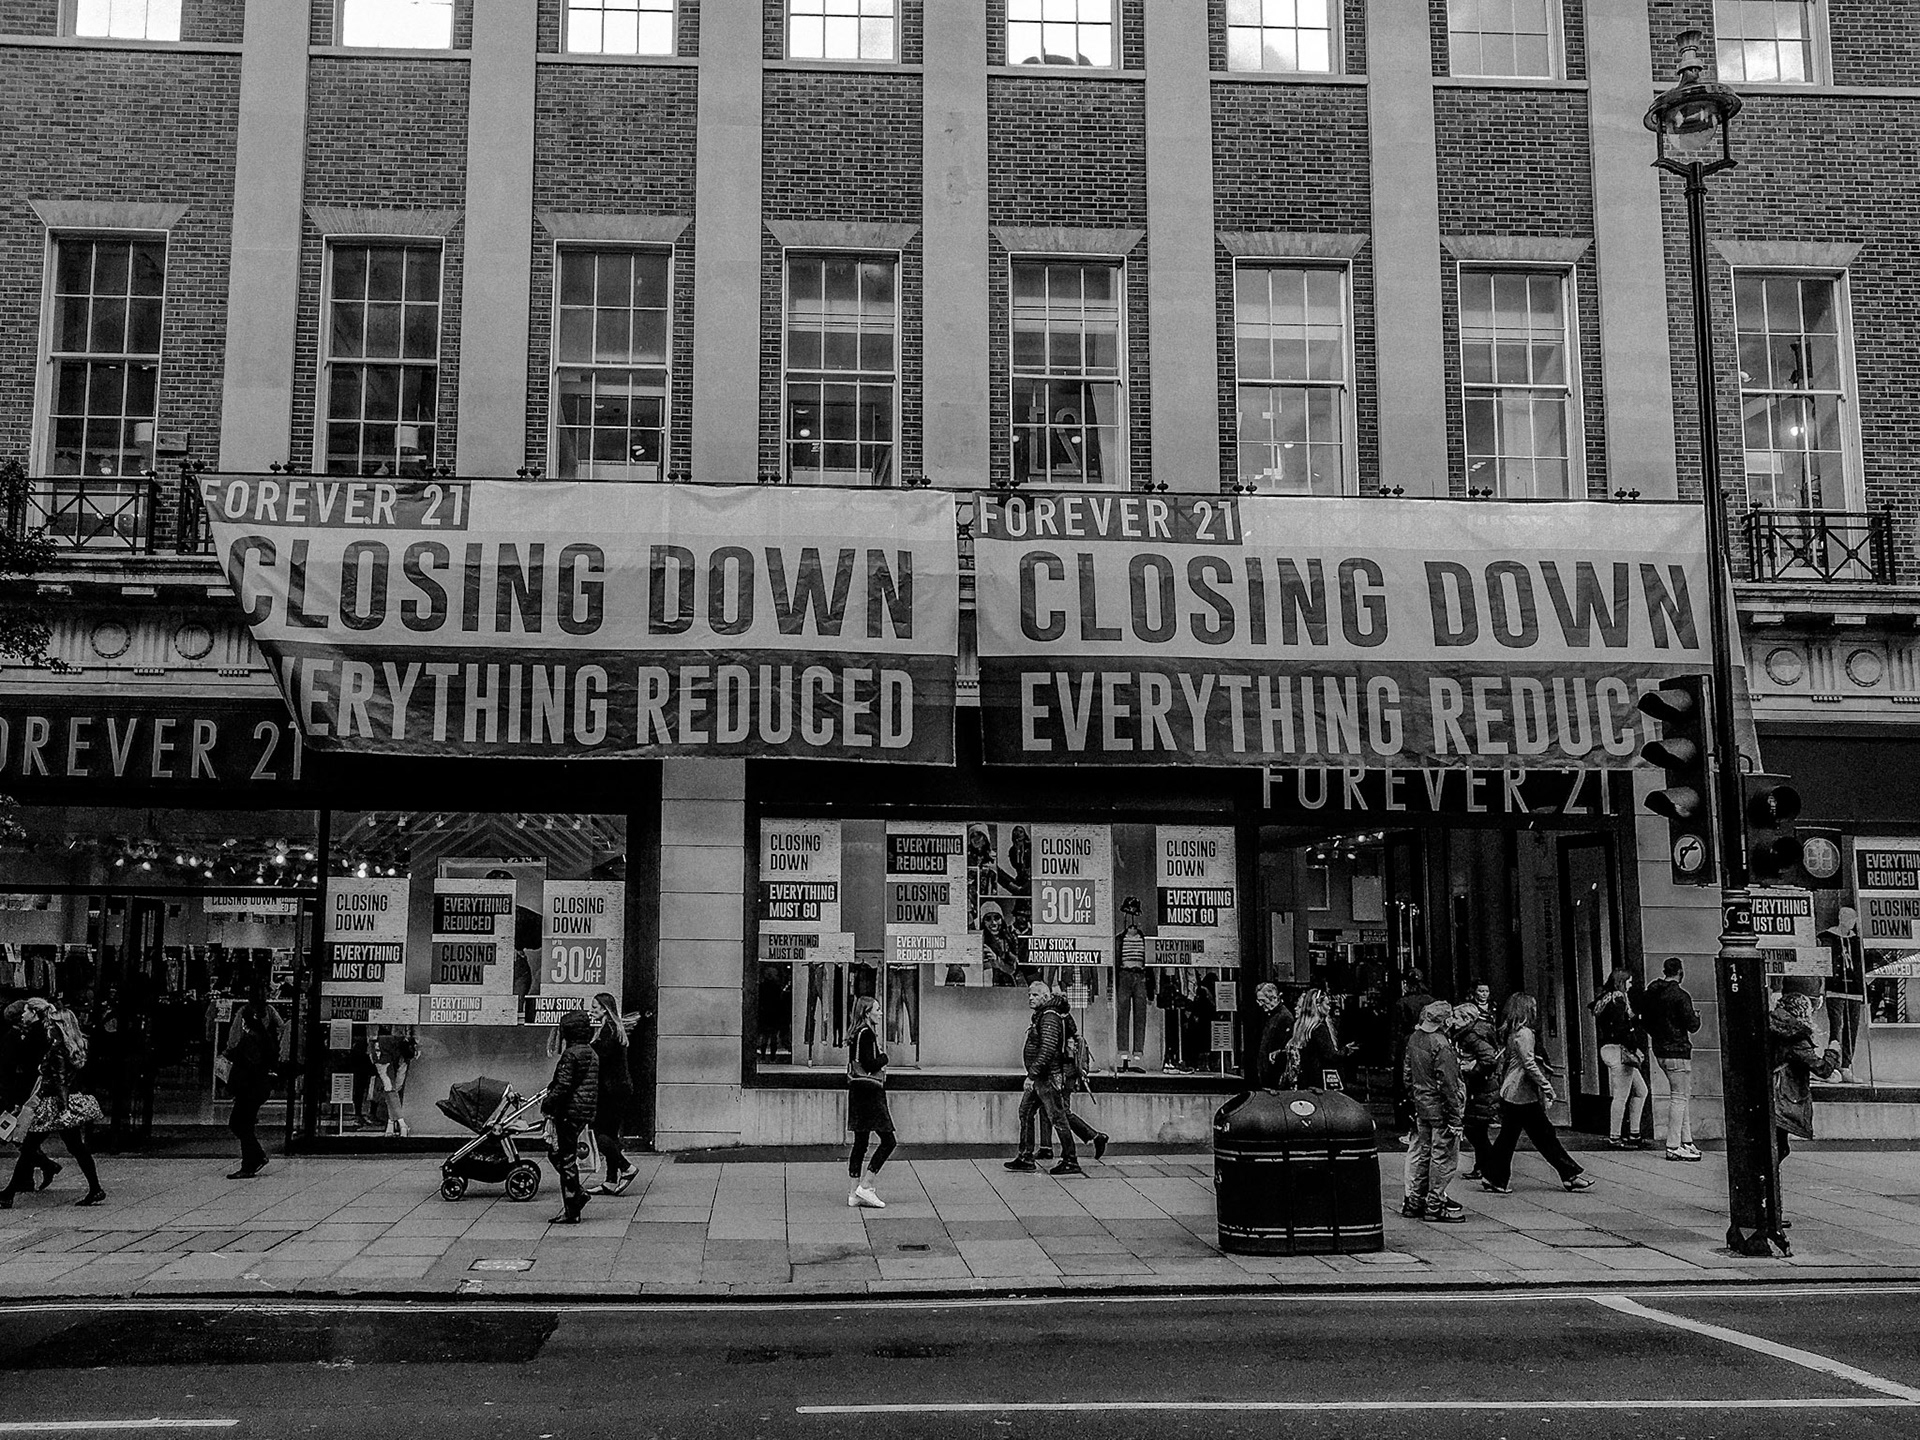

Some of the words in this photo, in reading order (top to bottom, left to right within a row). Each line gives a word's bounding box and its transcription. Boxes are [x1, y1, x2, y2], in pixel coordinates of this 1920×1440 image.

[201, 479, 397, 525] FOREVER
[421, 484, 464, 526] 21
[980, 496, 1172, 539] FOREVER
[1195, 501, 1236, 543] 21
[228, 535, 606, 636] CLOSING
[648, 545, 914, 641] DOWN
[1018, 550, 1390, 649] CLOSING
[1423, 560, 1700, 650] DOWN
[638, 665, 914, 750] REDUCED
[1021, 671, 1403, 757] EVERYTHING
[1429, 675, 1663, 757] REDUC
[250, 720, 302, 780] 21
[1263, 767, 1529, 813] FOREVER
[770, 834, 821, 851] CLOSING
[896, 838, 961, 854] EVERYTHING
[1041, 838, 1091, 855] CLOSING
[1166, 840, 1216, 857] CLOSING
[770, 854, 808, 871] DOWN
[896, 856, 943, 871] REDUCED
[1041, 858, 1080, 874] DOWN
[1167, 860, 1205, 876] DOWN
[1867, 871, 1915, 886] REDUCED
[769, 884, 835, 900] EVERYTHING
[896, 884, 947, 902] CLOSING
[1166, 890, 1232, 906] EVERYTHING
[336, 894, 388, 912] CLOSING
[443, 896, 510, 913] EVERYTHING
[553, 897, 604, 914] CLOSING
[769, 902, 800, 918] MUST
[803, 903, 817, 918] GO
[1869, 899, 1920, 917] CLOSING
[897, 905, 935, 921] DOWN
[1074, 910, 1091, 923] OFF
[1167, 908, 1197, 923] MUST
[1200, 908, 1215, 924] GO
[335, 914, 375, 931] DOWN
[443, 915, 492, 931] REDUCED
[553, 917, 592, 934] DOWN
[1753, 916, 1774, 932] UST
[1776, 917, 1791, 932] GO
[1871, 919, 1910, 936] DOWN
[769, 934, 819, 947] EVERYTHING
[897, 936, 945, 948] EVERYTHING
[1028, 938, 1048, 950] NEW
[1049, 938, 1074, 950] STOCK
[1155, 939, 1204, 951] EVERYTHING
[333, 945, 400, 962] EVERYTHING
[441, 945, 493, 962] CLOSING
[769, 948, 791, 959] MUST
[793, 948, 804, 959] GO
[897, 950, 932, 961] REDUCED
[1028, 951, 1066, 964] ARRIVING
[1066, 951, 1100, 964] WEEKLY
[1155, 953, 1178, 964] MUST
[1179, 953, 1191, 964] GO
[332, 963, 363, 979] MUST
[365, 964, 382, 980] GO
[441, 965, 480, 983] DOWN
[585, 970, 601, 982] OFF
[331, 997, 382, 1010] EVERYTHING
[430, 997, 480, 1009] EVERYTHING
[535, 998, 554, 1010] NEW
[556, 998, 582, 1010] STOCK
[430, 1011, 467, 1022] REDUCED
